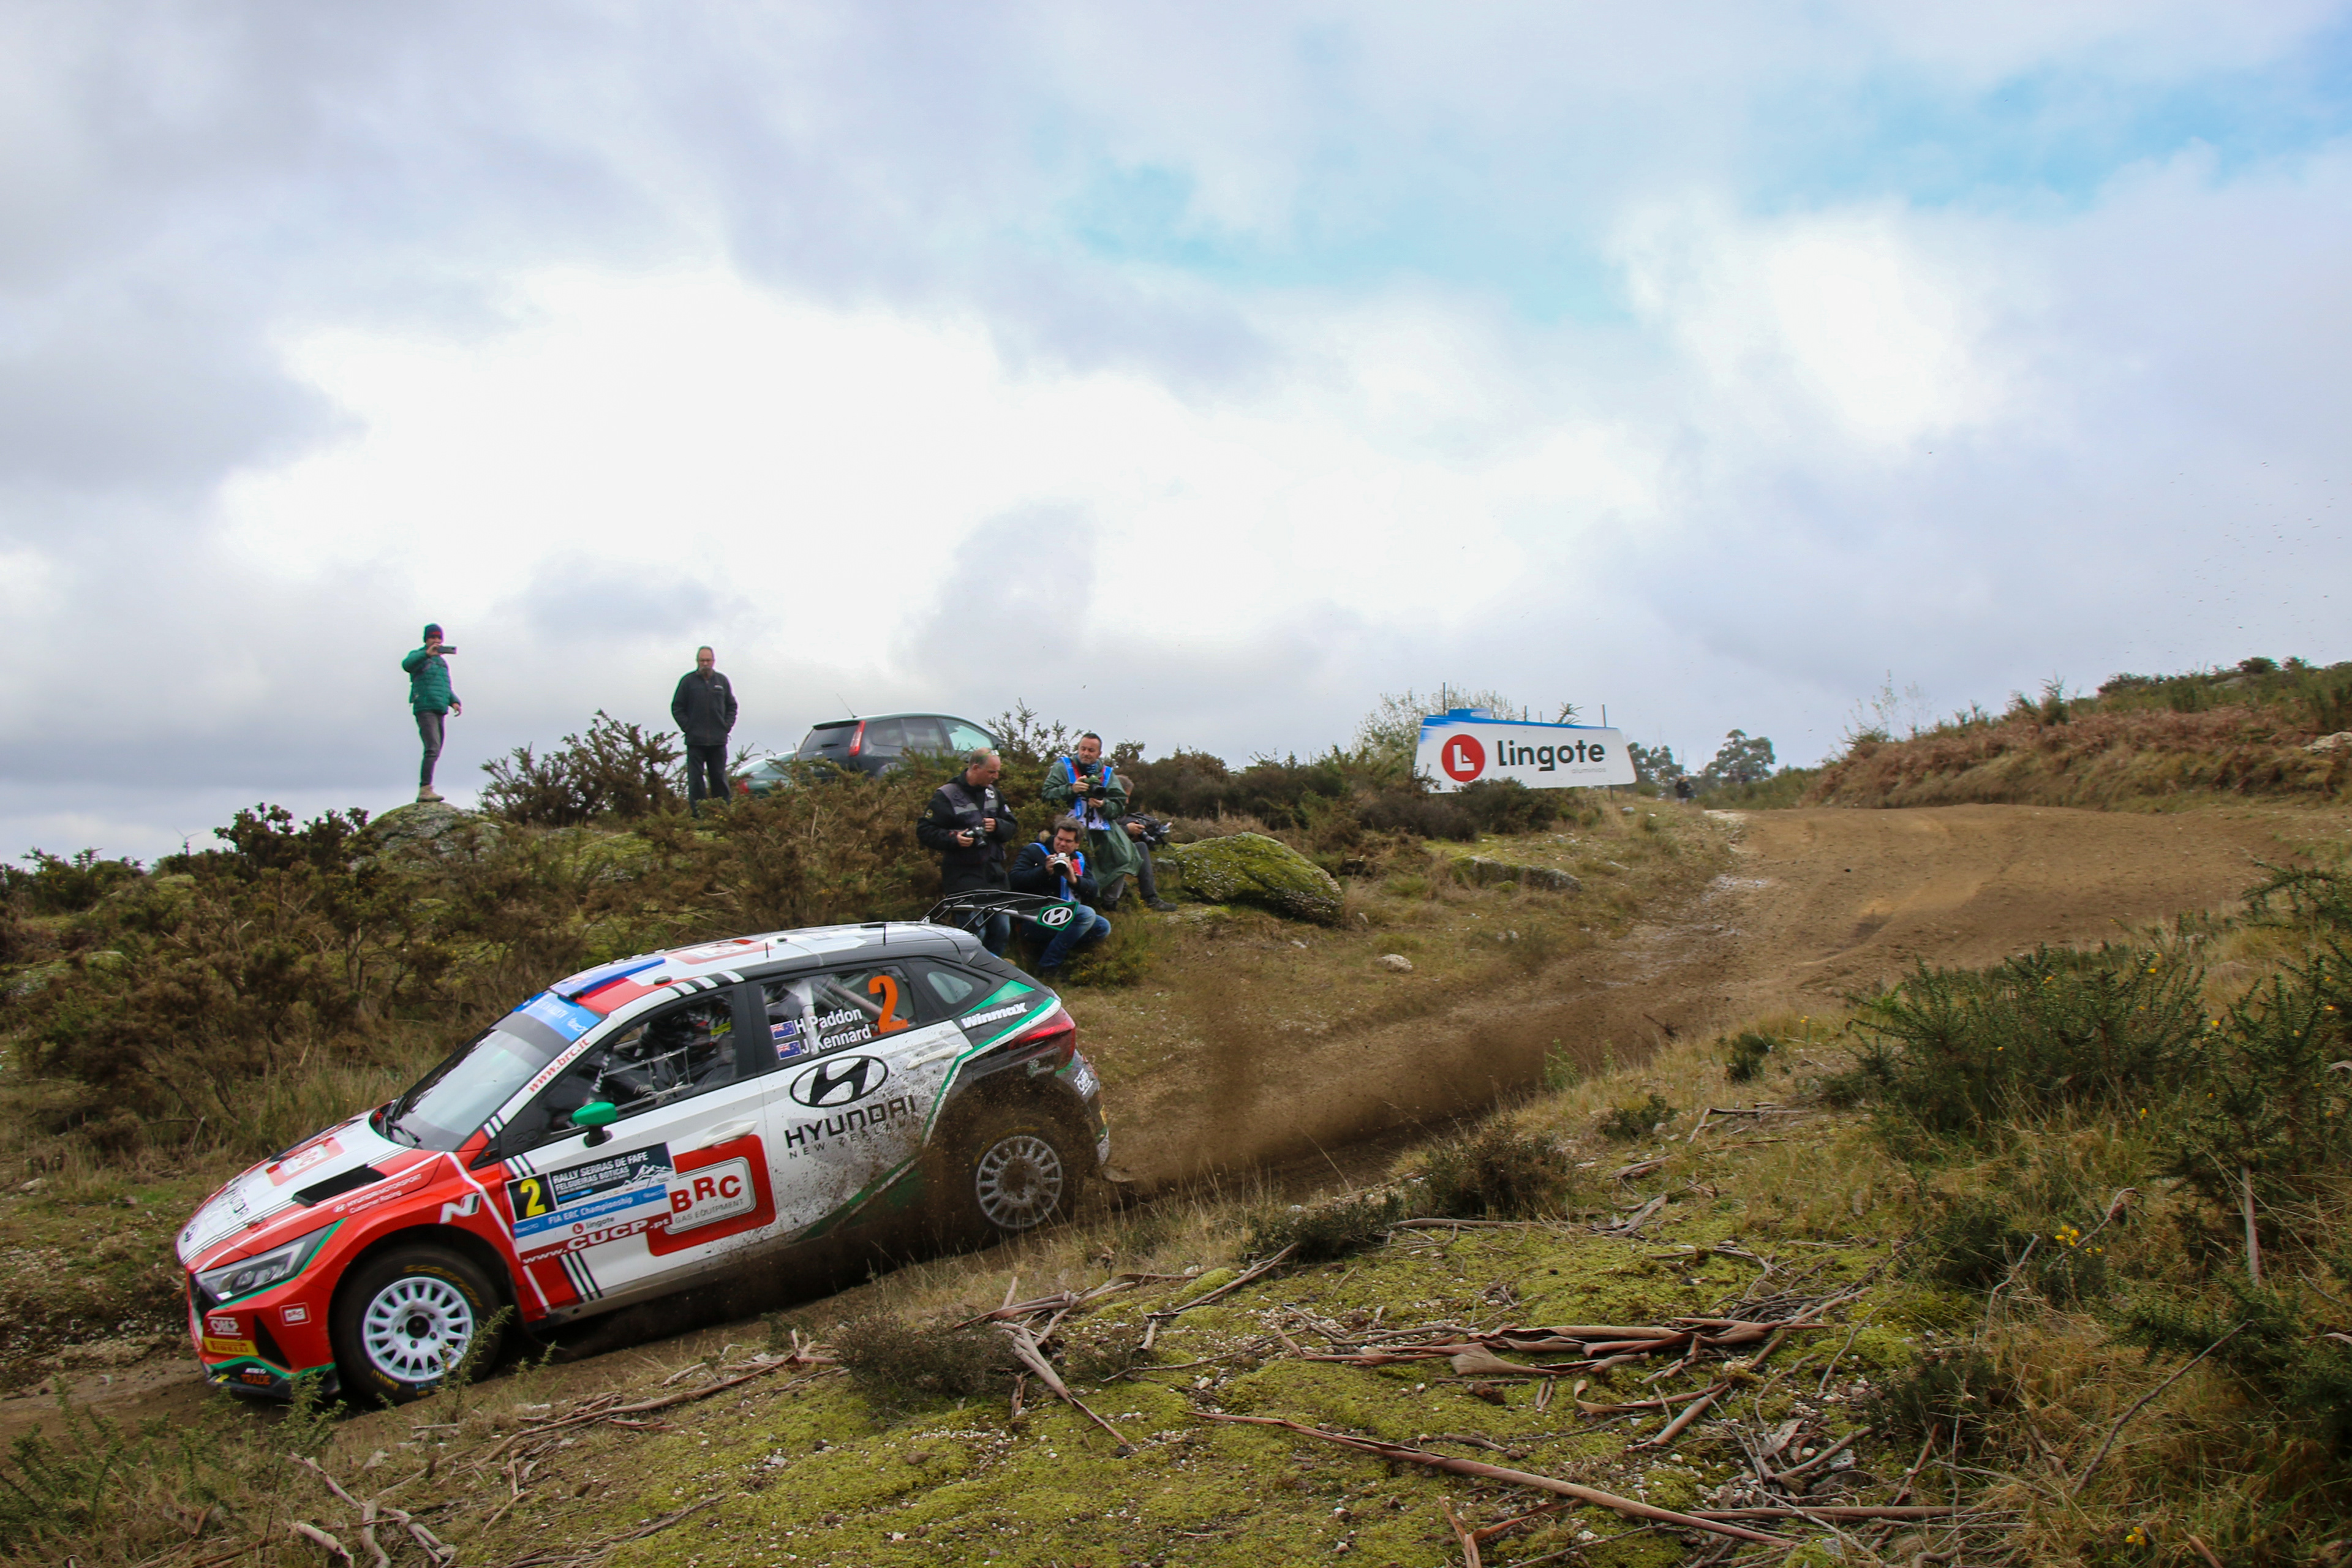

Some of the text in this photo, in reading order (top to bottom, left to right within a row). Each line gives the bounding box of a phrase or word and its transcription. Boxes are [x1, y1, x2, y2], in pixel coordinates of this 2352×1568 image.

[868, 975, 908, 1034] 2
[794, 1008, 862, 1035] H.Paddon
[802, 1023, 872, 1055] J.Kennard
[529, 1038, 590, 1093] www.brc.it
[784, 1095, 916, 1148] HYUNDAI
[789, 1142, 826, 1159] NEW
[552, 1169, 579, 1185] RALLY
[580, 1160, 614, 1178] SERRAS
[614, 1156, 628, 1167] DE
[627, 1151, 650, 1165] FAFE
[555, 1175, 599, 1192] FELGUEIRAS
[599, 1166, 630, 1180] BOTICAS
[347, 1173, 422, 1207] HYUNDAI MOTORSPORT
[349, 1190, 402, 1214] Customer Racing
[520, 1178, 547, 1218] 2
[669, 1175, 742, 1215] BRC
[548, 1196, 634, 1225] FIA ERC Championship
[674, 1198, 744, 1224] GAS EQUIPMENT
[522, 1218, 671, 1264] www.CUCP.pt
[240, 1374, 271, 1385] TRADE
